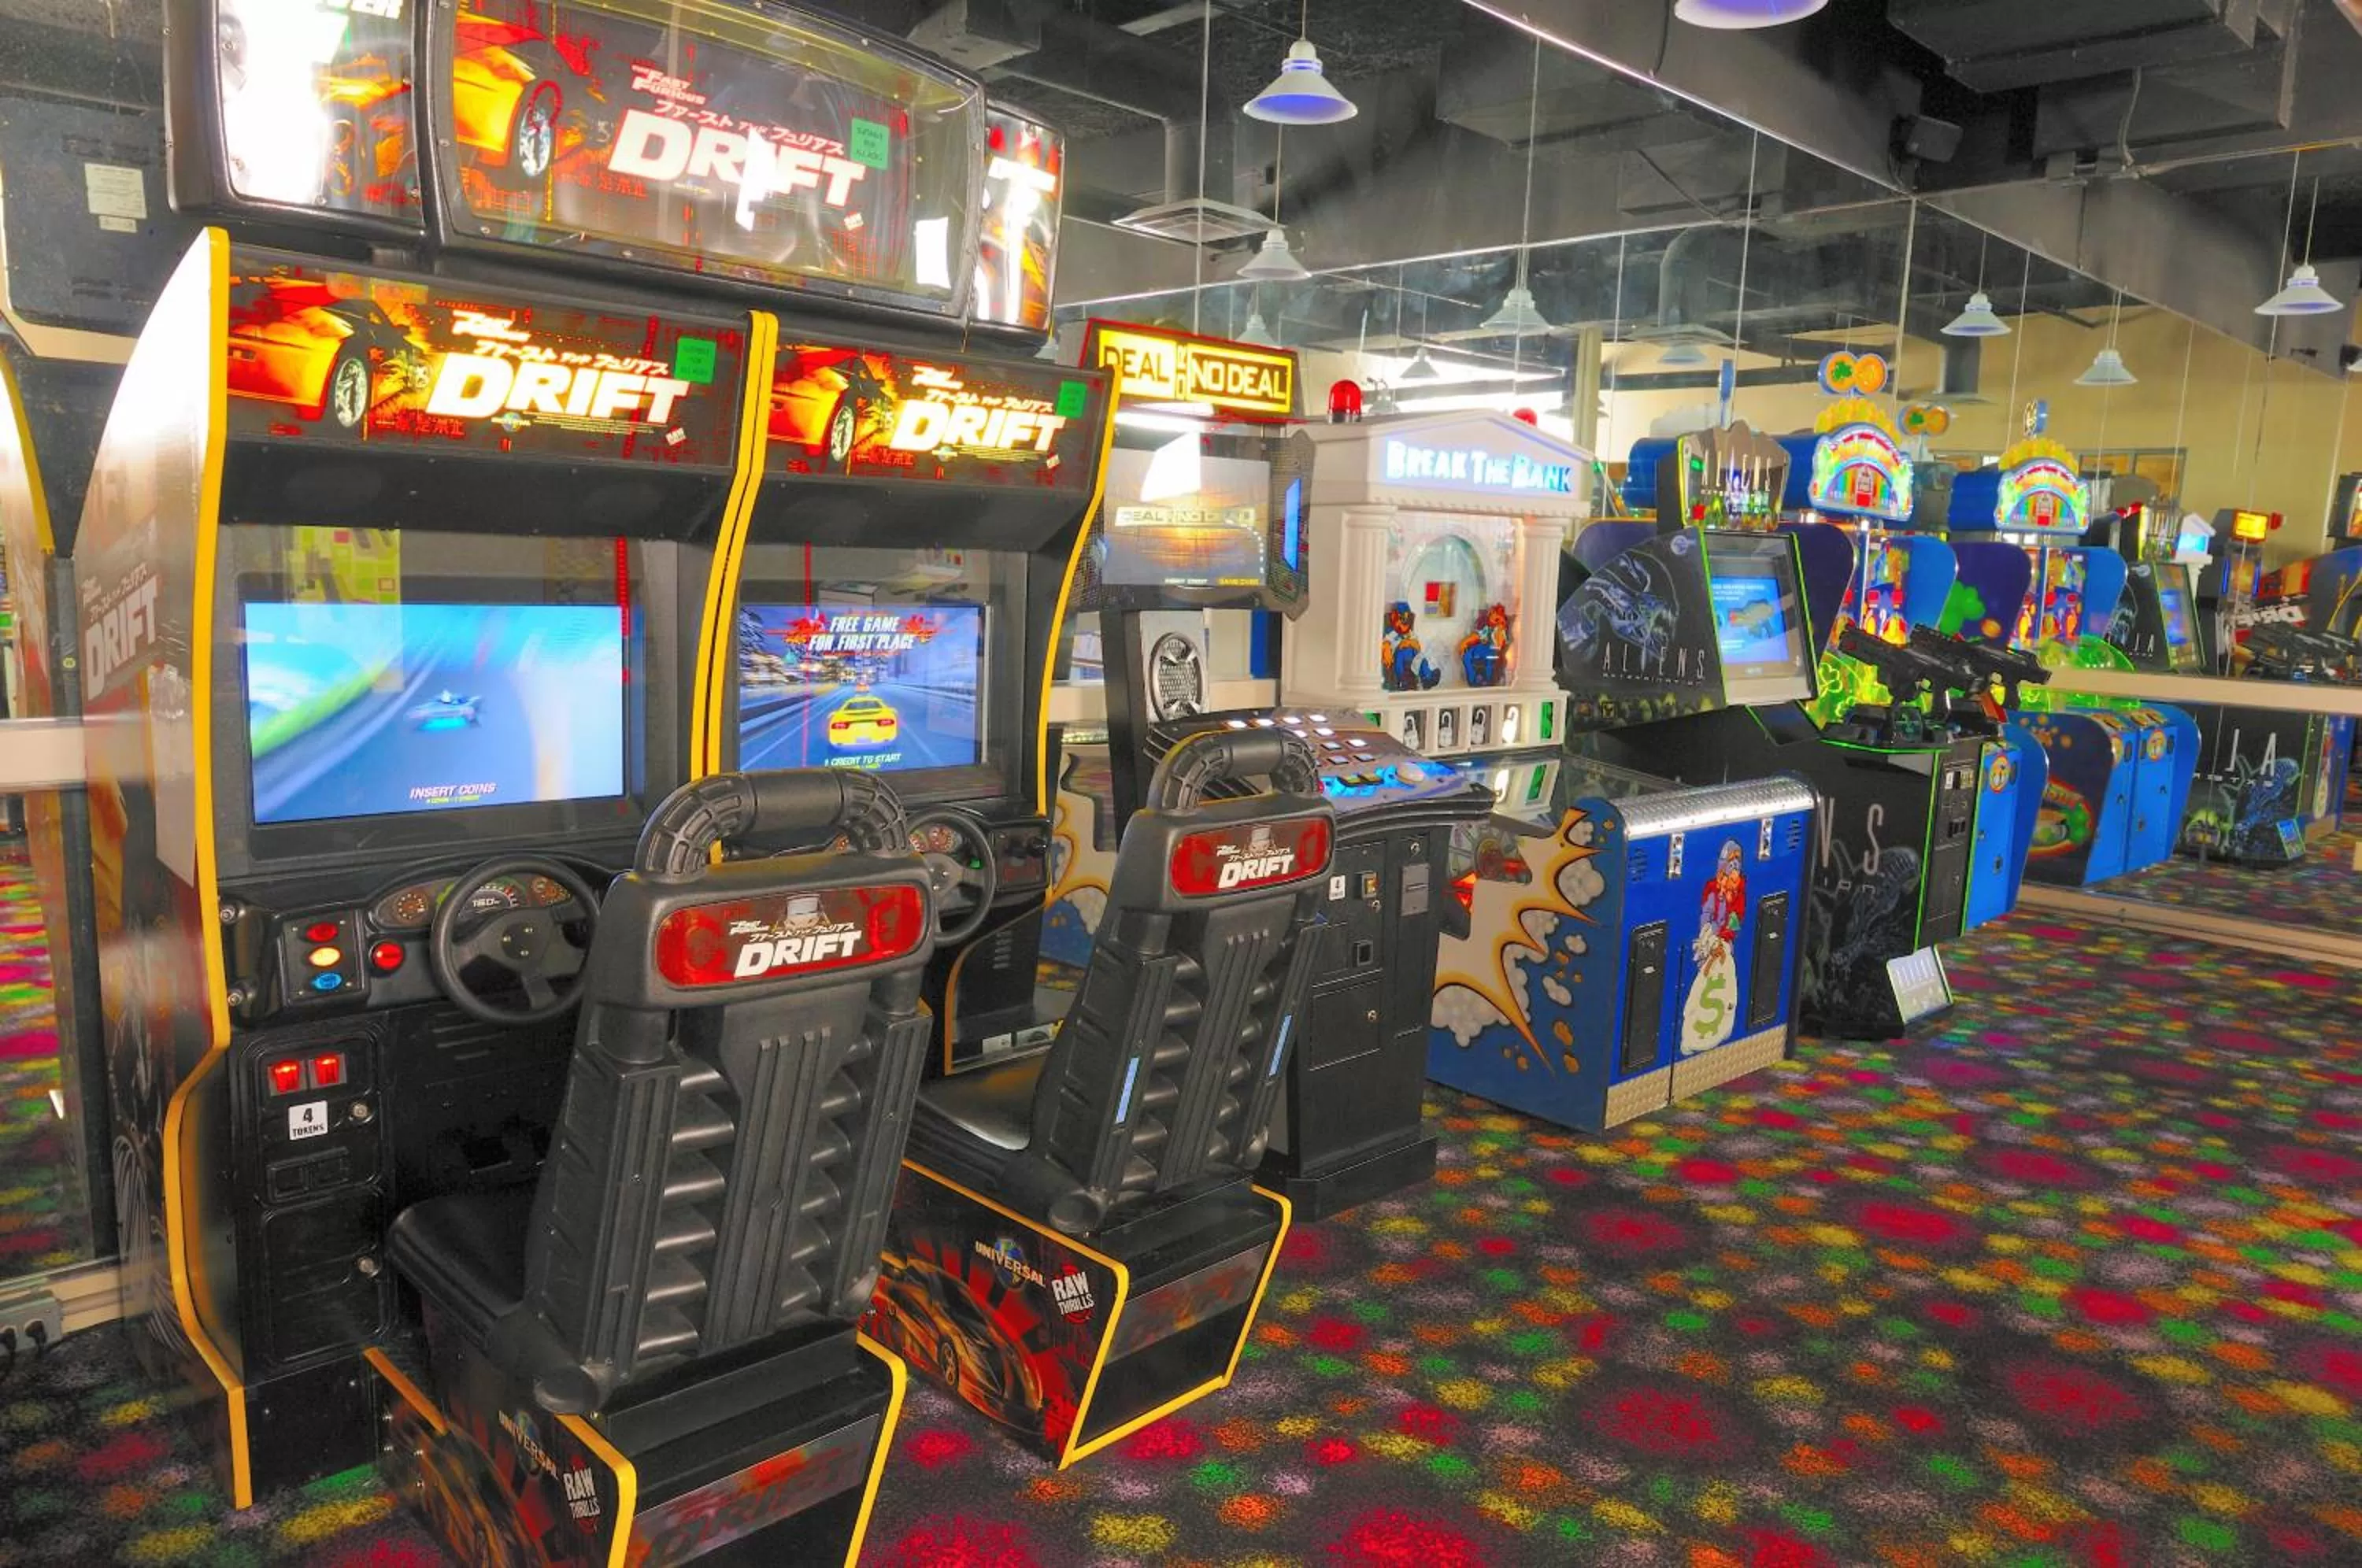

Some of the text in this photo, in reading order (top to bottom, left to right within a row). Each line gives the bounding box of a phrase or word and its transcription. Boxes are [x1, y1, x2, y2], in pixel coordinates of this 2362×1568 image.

[425, 352, 690, 423] DRIFT
[1227, 364, 1287, 400] DEAL
[890, 398, 1067, 452] DRIFT
[1386, 440, 1572, 493] BREAK THE BANK
[86, 575, 157, 701] DRIFT
[829, 616, 901, 633] FREE GAME
[809, 634, 916, 651] FOR FIRST PLACE
[1601, 642, 1706, 680] ALIENS
[831, 756, 861, 767] CREDIT
[862, 755, 875, 764] TO
[875, 753, 902, 763] START
[409, 786, 457, 800] INSERT
[458, 782, 497, 795] COINS
[1217, 854, 1295, 889] DRIFT
[733, 930, 862, 978] DRIFT
[292, 1123, 325, 1137] TOKENS
[302, 1108, 313, 1123] 4
[975, 1240, 1046, 1289] UNIVERSAL
[1051, 1271, 1090, 1301] RAW
[1057, 1293, 1095, 1315] THRILLS
[498, 1410, 558, 1480] UNIVERSAL
[563, 1467, 596, 1501] RAW
[569, 1496, 601, 1519] THRILLS
